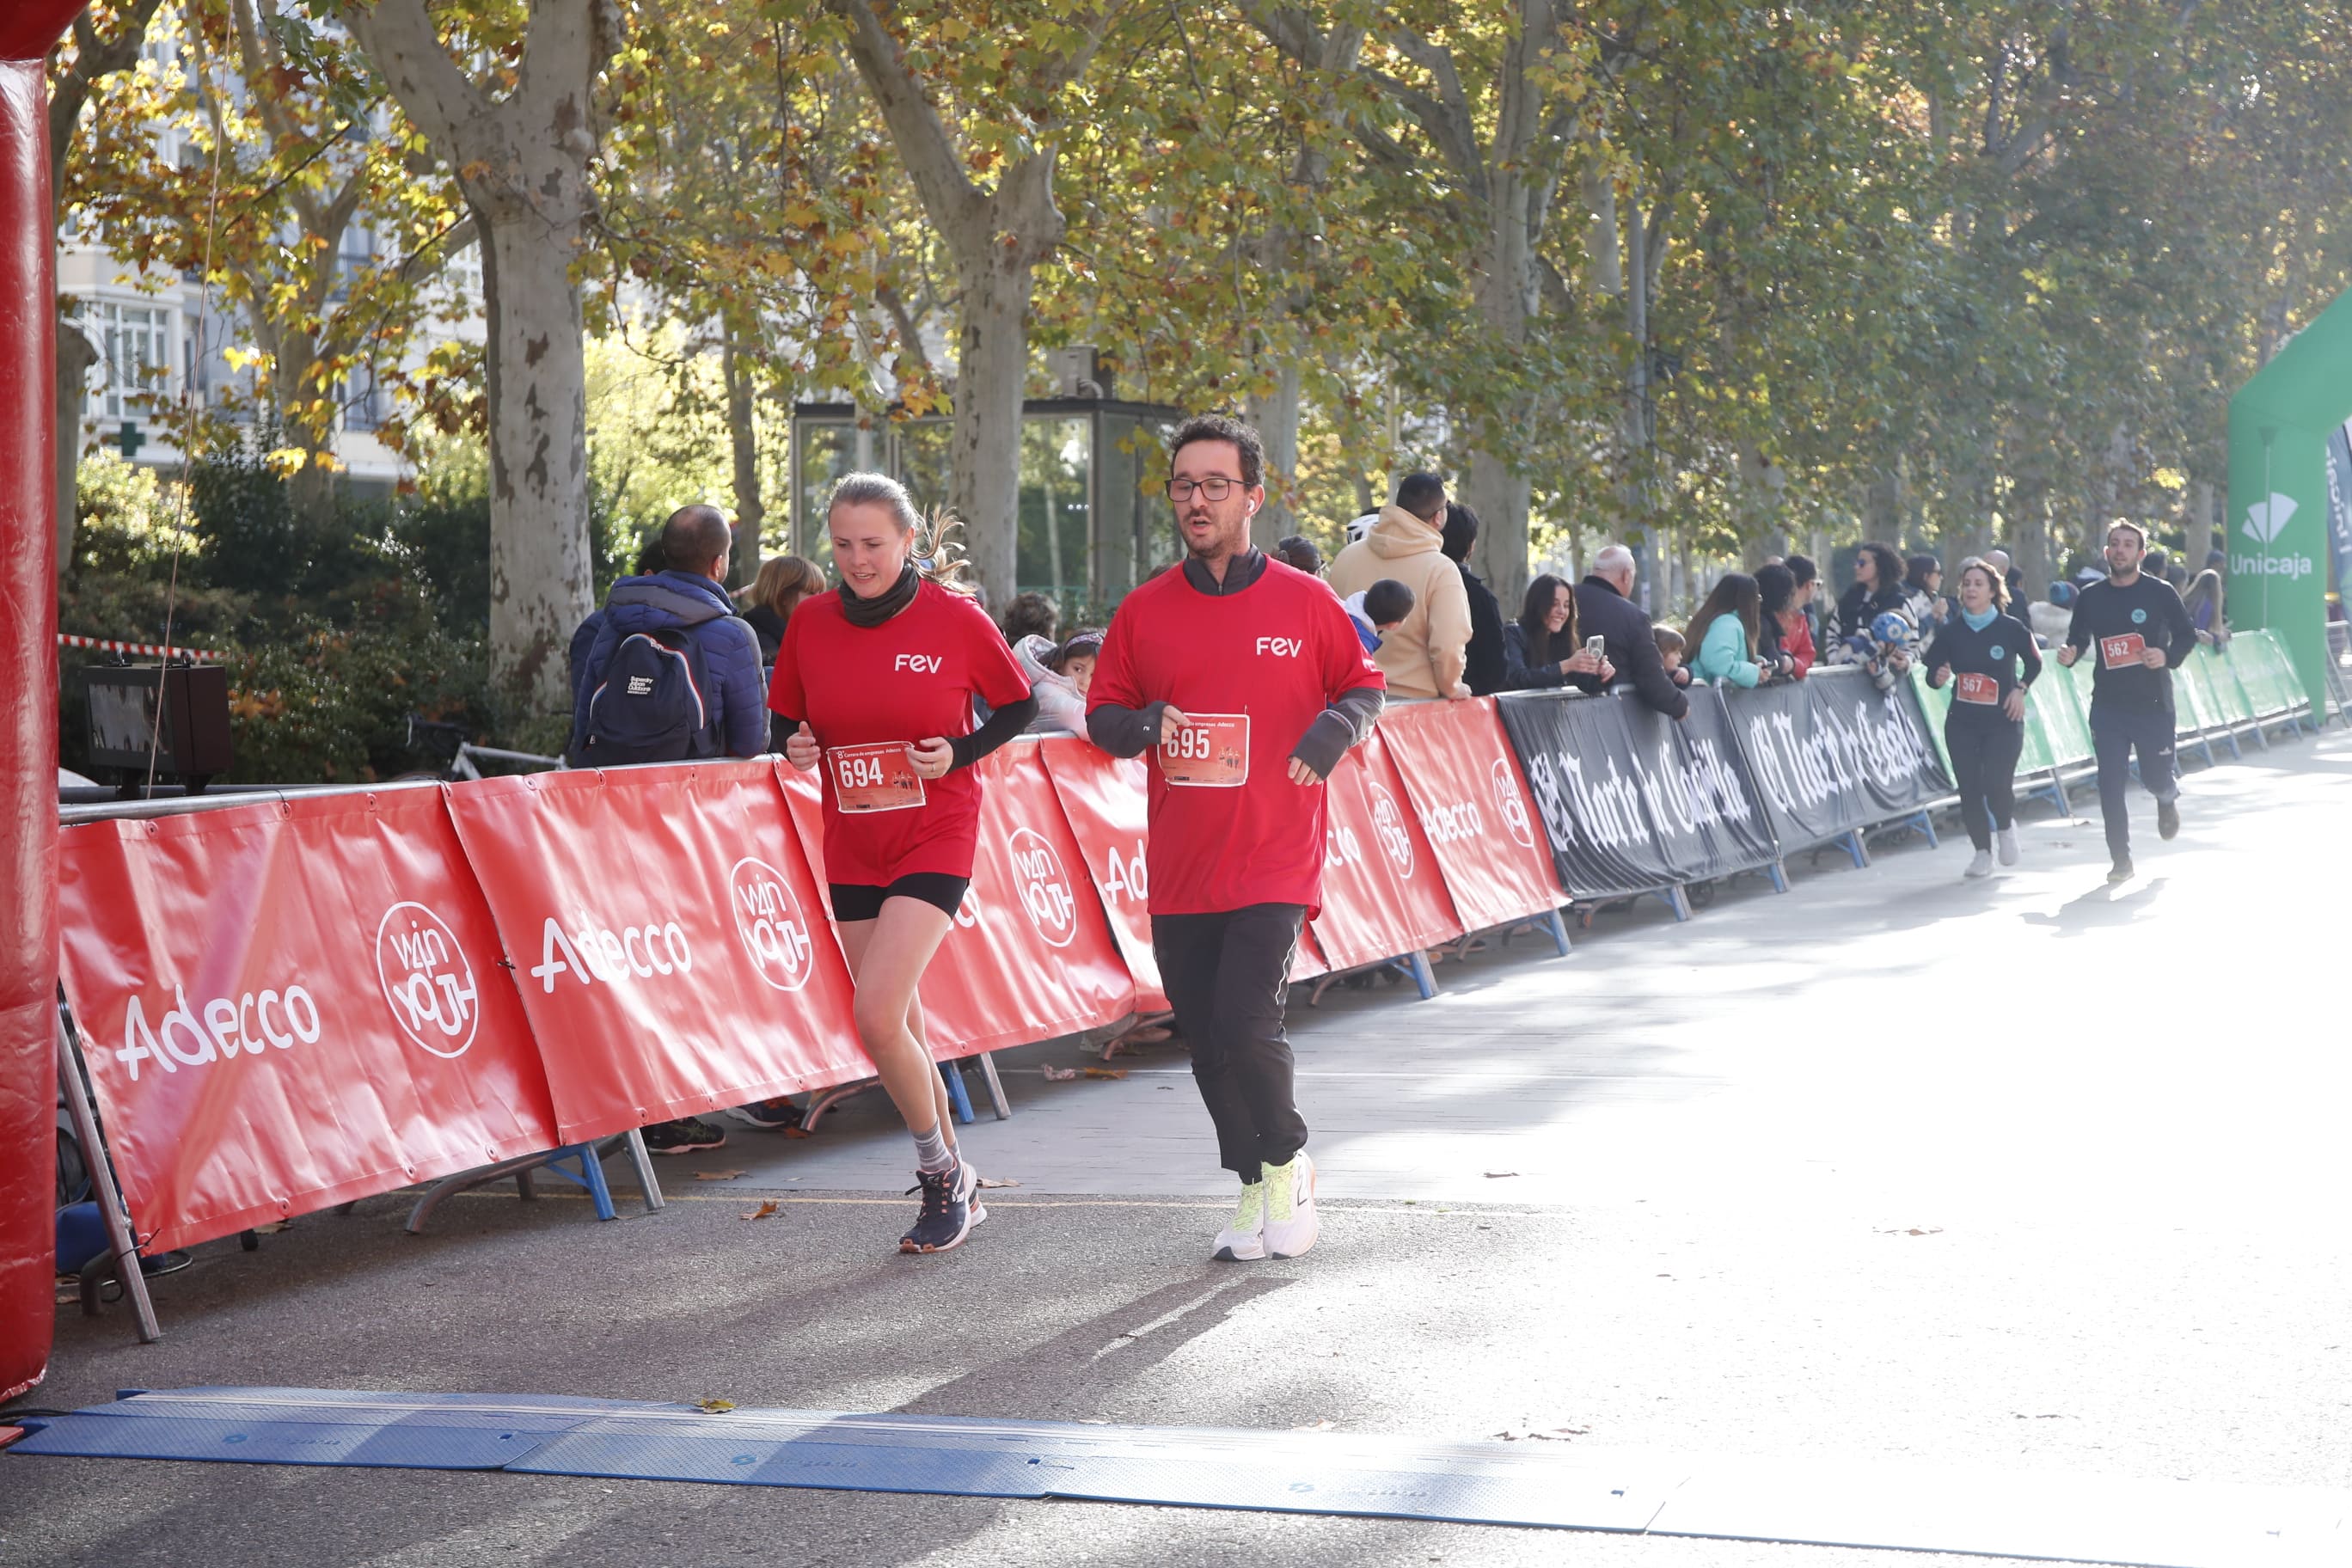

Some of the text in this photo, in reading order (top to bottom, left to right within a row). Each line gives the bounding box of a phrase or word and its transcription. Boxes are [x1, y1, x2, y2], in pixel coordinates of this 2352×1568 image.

[2231, 551, 2312, 581] Unicaja
[2108, 641, 2129, 658] 562
[1963, 677, 1982, 693] 567
[1167, 728, 1210, 759] 695
[839, 757, 884, 788] 694
[1559, 751, 1651, 854] Norte
[1632, 751, 1675, 838] de
[1418, 796, 1484, 844] Adecco
[530, 910, 693, 994] Adecco
[115, 983, 321, 1081] Adecco
